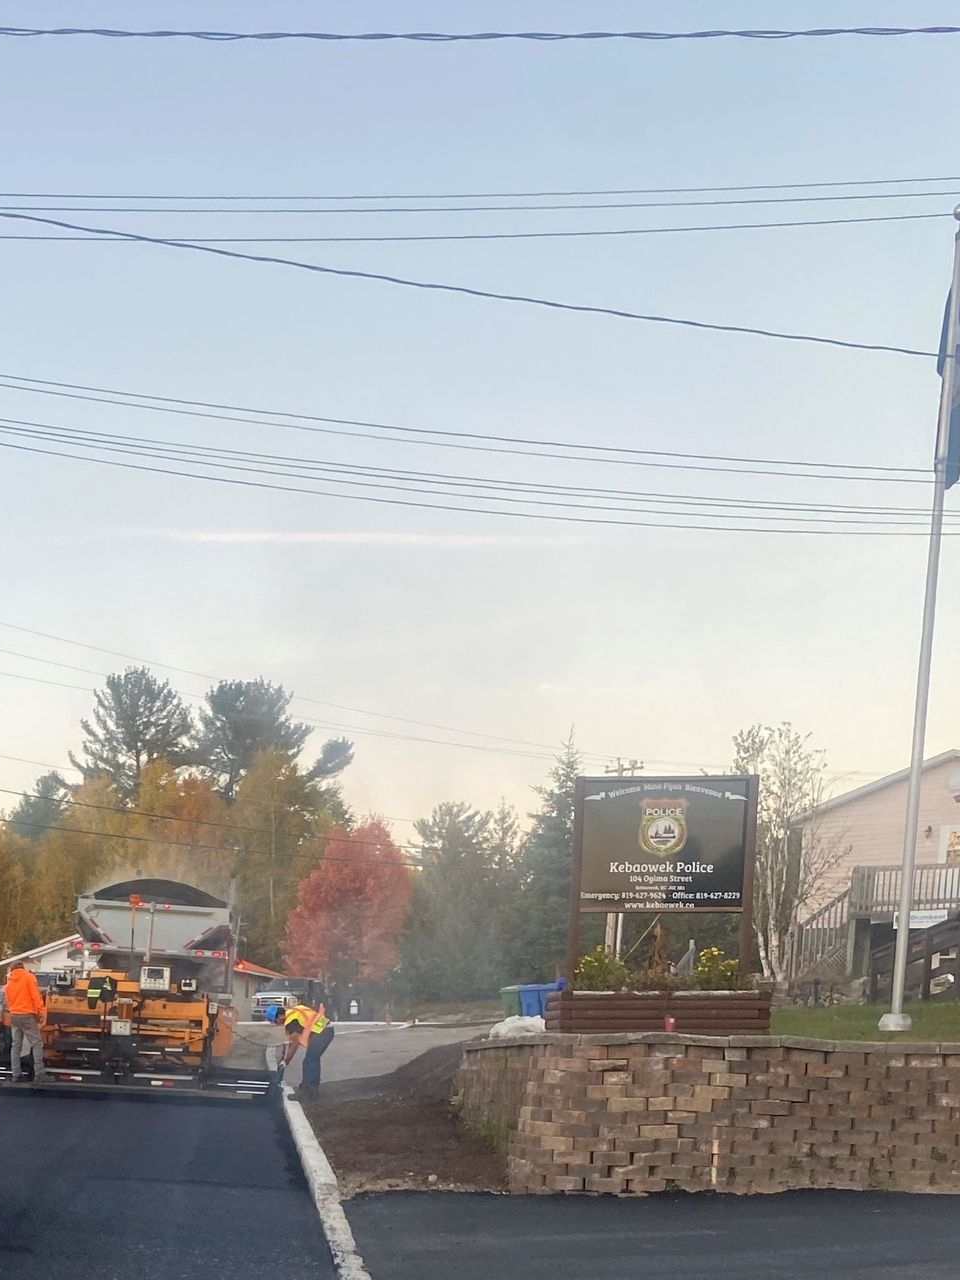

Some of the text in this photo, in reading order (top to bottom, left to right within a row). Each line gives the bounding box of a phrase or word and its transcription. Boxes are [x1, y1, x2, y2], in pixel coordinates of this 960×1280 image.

[608, 785, 641, 799] Welcome
[646, 808, 683, 816] POLICE
[609, 861, 714, 873] Kebaowek Police
[629, 875, 693, 884] 104 Ogima Street
